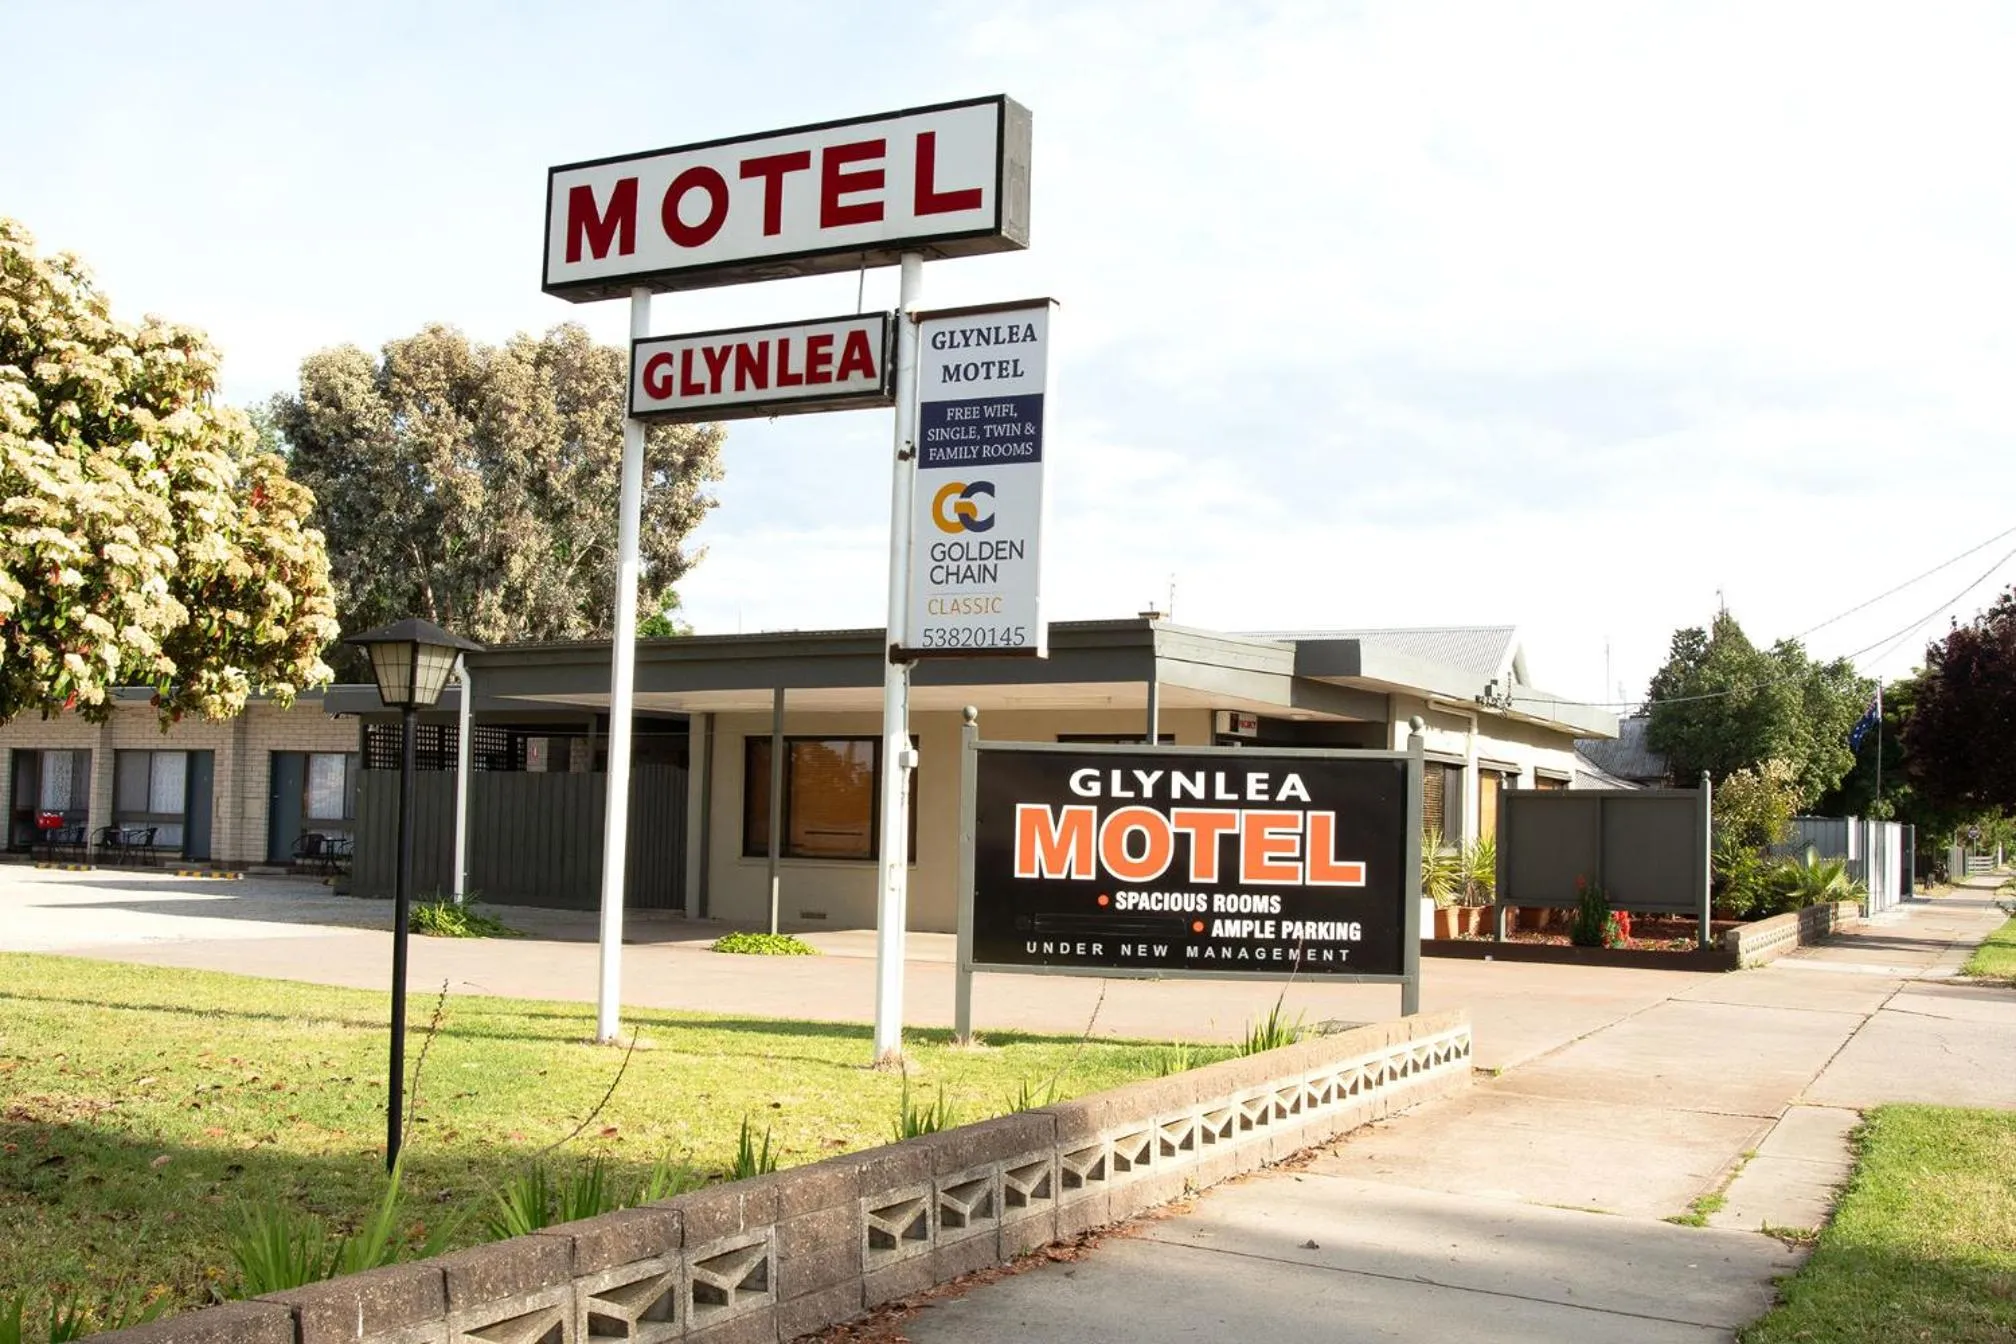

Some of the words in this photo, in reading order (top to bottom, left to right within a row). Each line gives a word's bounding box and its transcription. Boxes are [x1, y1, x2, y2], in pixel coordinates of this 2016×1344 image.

[565, 131, 983, 263] MOTEL
[931, 323, 1037, 350] GLYNLEA
[642, 329, 877, 400] GLYNLEA
[941, 359, 1024, 383] MOTEL
[946, 406, 980, 421] FREE
[983, 404, 1017, 418] WIFI,
[927, 426, 980, 441] SINGLE,
[983, 423, 1022, 438] TWIN
[1024, 422, 1036, 435] &
[929, 446, 980, 461] FAMILY
[982, 442, 1033, 458] ROOMS
[930, 539, 1024, 562] GOLDEN
[930, 563, 998, 585] CHAIN
[928, 597, 1003, 615] CLASSIC
[922, 626, 1025, 648] 53820145
[1069, 768, 1311, 801] GLYNLEA
[1014, 803, 1366, 887] MOTEL
[1115, 891, 1207, 912] SPACIOUS
[1213, 893, 1281, 914] ROOMS
[1211, 919, 1275, 939] AMPLE
[1281, 920, 1361, 941] PARKING
[1026, 941, 1104, 955] UNDER
[1120, 944, 1168, 957] NEW
[1186, 945, 1350, 962] MANAGEMENT
